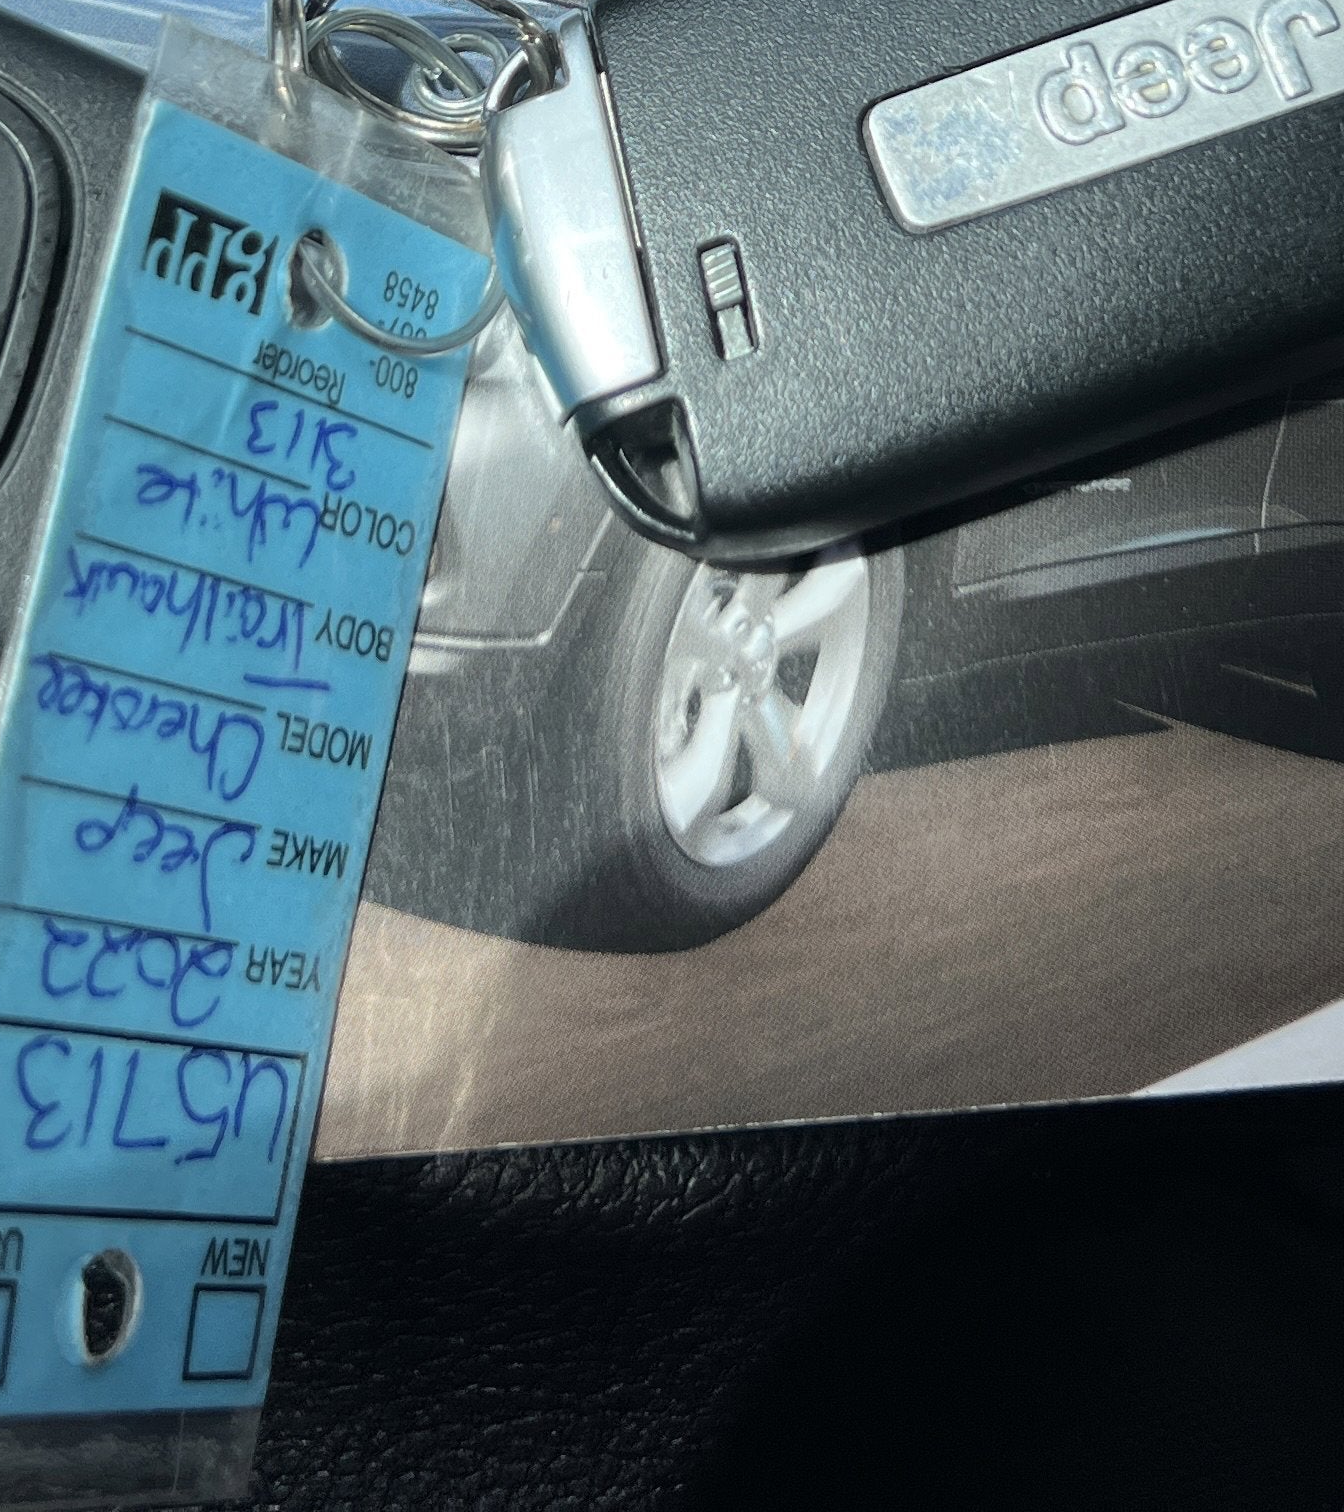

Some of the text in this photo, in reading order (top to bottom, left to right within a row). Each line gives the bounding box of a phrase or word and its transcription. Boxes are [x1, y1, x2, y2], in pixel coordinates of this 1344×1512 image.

[383, 270, 440, 320] 8458
[255, 340, 346, 406] Reorder
[369, 355, 420, 399] 800-
[136, 463, 415, 569] COLOR White
[63, 545, 394, 691] BODY Trailhawk
[30, 653, 372, 801] MODEL Cherokee
[74, 784, 349, 932] MAKE Jeep
[40, 917, 322, 1028] YEAR 2022
[18, 1034, 289, 1166] U5713
[201, 1237, 269, 1278] NEW
